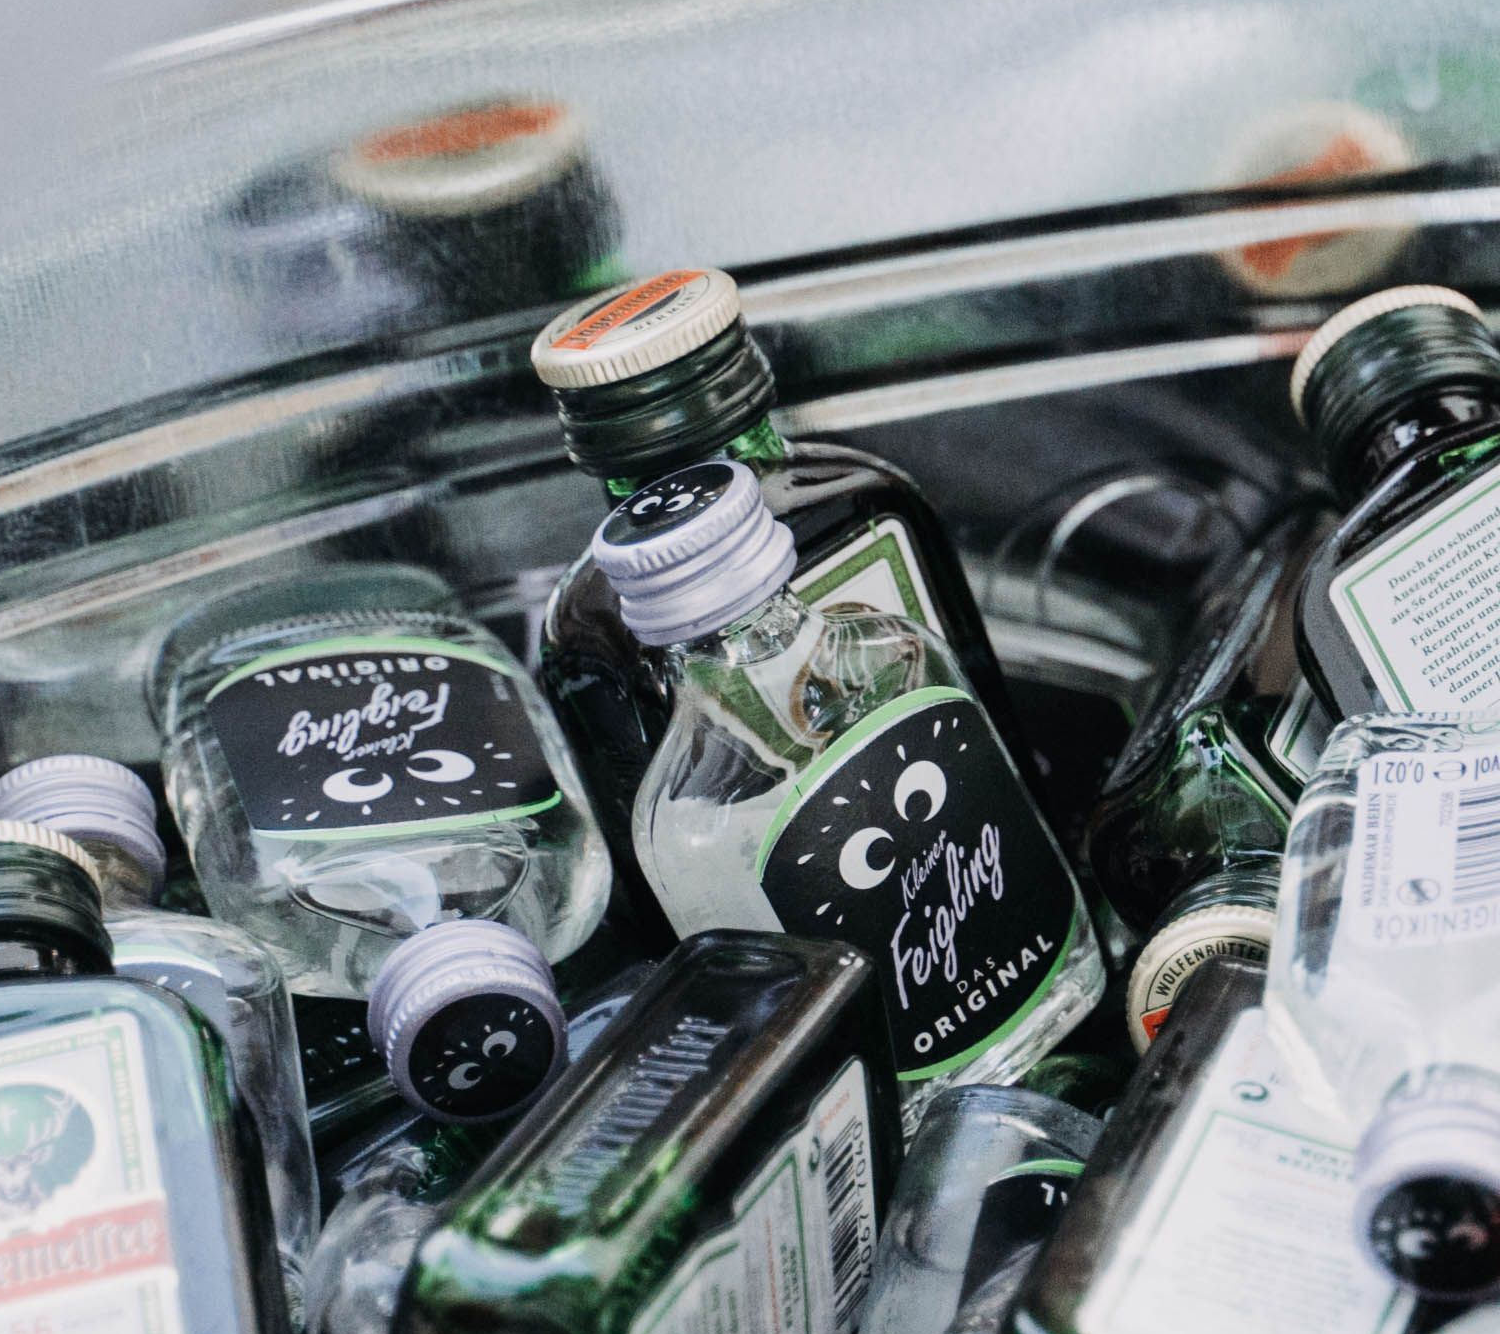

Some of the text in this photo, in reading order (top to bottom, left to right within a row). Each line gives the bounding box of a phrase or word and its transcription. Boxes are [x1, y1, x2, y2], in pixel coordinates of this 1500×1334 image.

[1387, 558, 1427, 590] Durch
[1424, 544, 1447, 564] ein
[1390, 528, 1498, 607] Auszugsverfahren
[1389, 607, 1411, 625] aus
[1410, 595, 1427, 610] 56
[1425, 556, 1483, 600] erlesenen
[1411, 584, 1468, 627] Wurzeln,
[1409, 604, 1465, 647] Früchten
[1462, 584, 1494, 610] nach
[1421, 615, 1478, 659] Rezeptur
[254, 654, 449, 687] ORIGINAL
[1419, 626, 1486, 677] extrahiert,
[1427, 640, 1493, 689] Eichenfass
[1446, 666, 1480, 694] dann
[1458, 675, 1495, 705] unser
[277, 681, 448, 755] Feigling
[341, 729, 413, 761] Kleiner
[1474, 756, 1500, 780] vol
[1365, 792, 1380, 829] BEHN
[899, 829, 946, 908] Kleiner
[891, 824, 1001, 1009] Feigling
[911, 934, 1053, 1053] ORIGINAL
[955, 956, 996, 993] DAS
